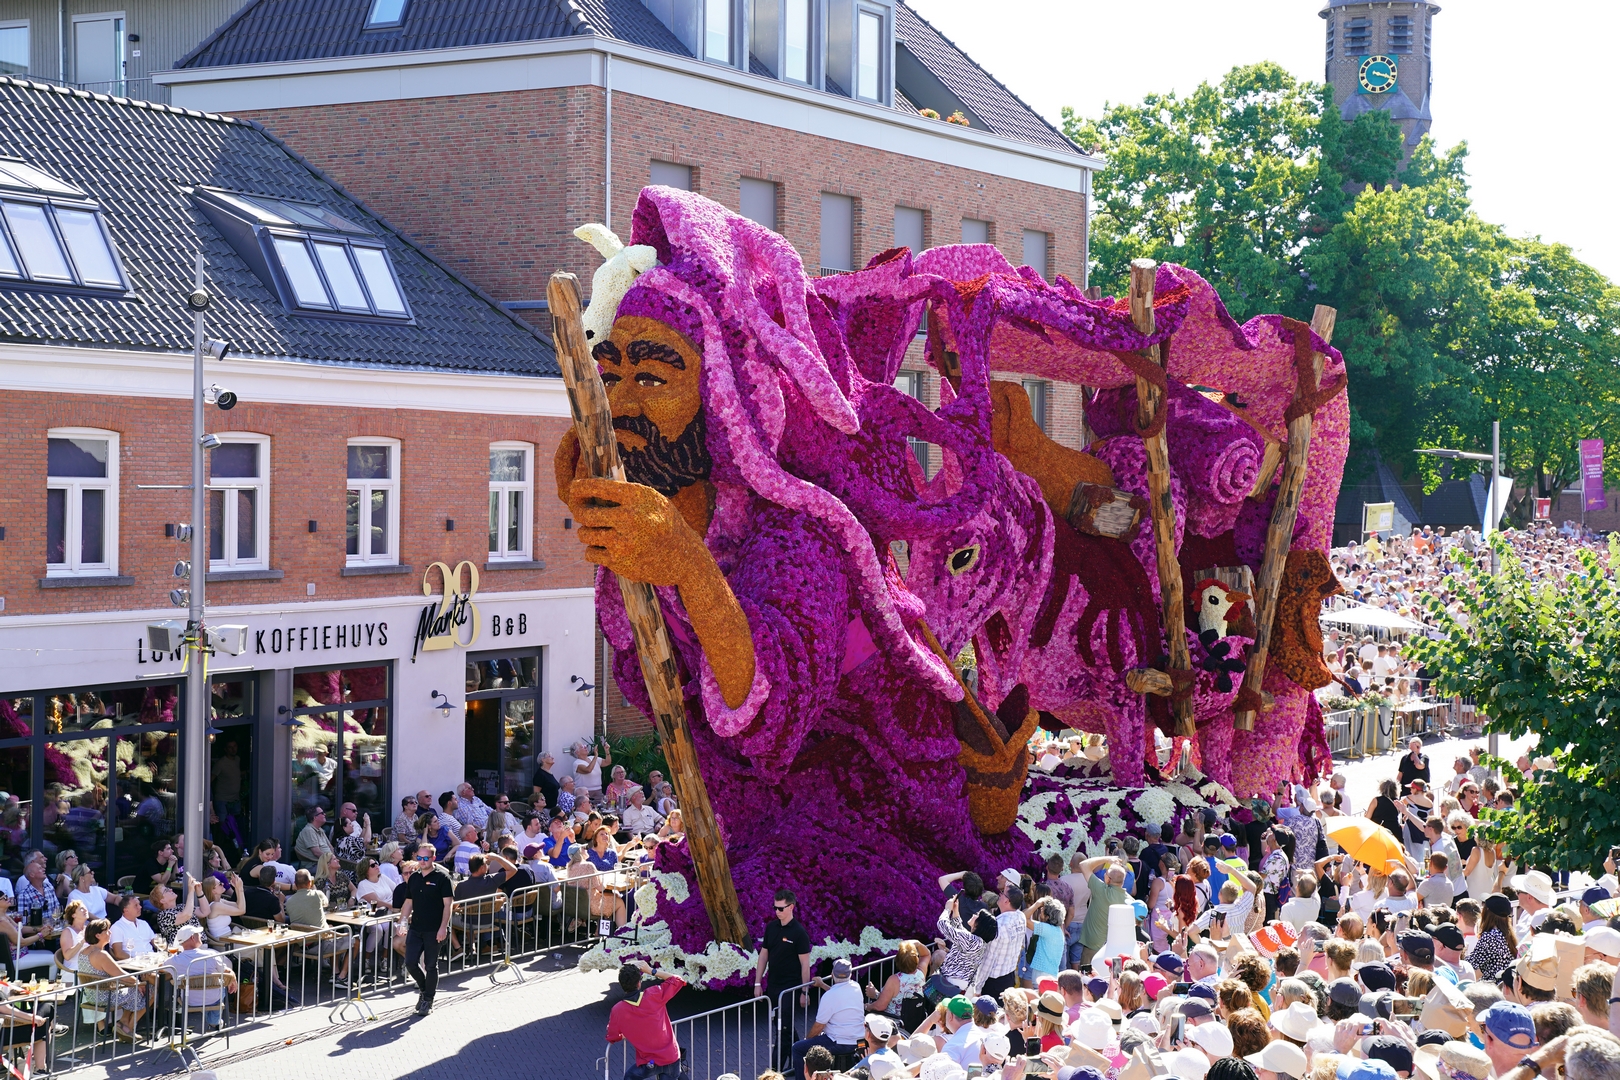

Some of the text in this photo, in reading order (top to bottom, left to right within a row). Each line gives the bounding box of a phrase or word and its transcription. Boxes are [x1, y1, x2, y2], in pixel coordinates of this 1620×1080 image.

[411, 594, 469, 664] Markt
[423, 561, 481, 651] 28
[255, 622, 388, 655] KOFFIEHUYS
[601, 922, 610, 930] 15
